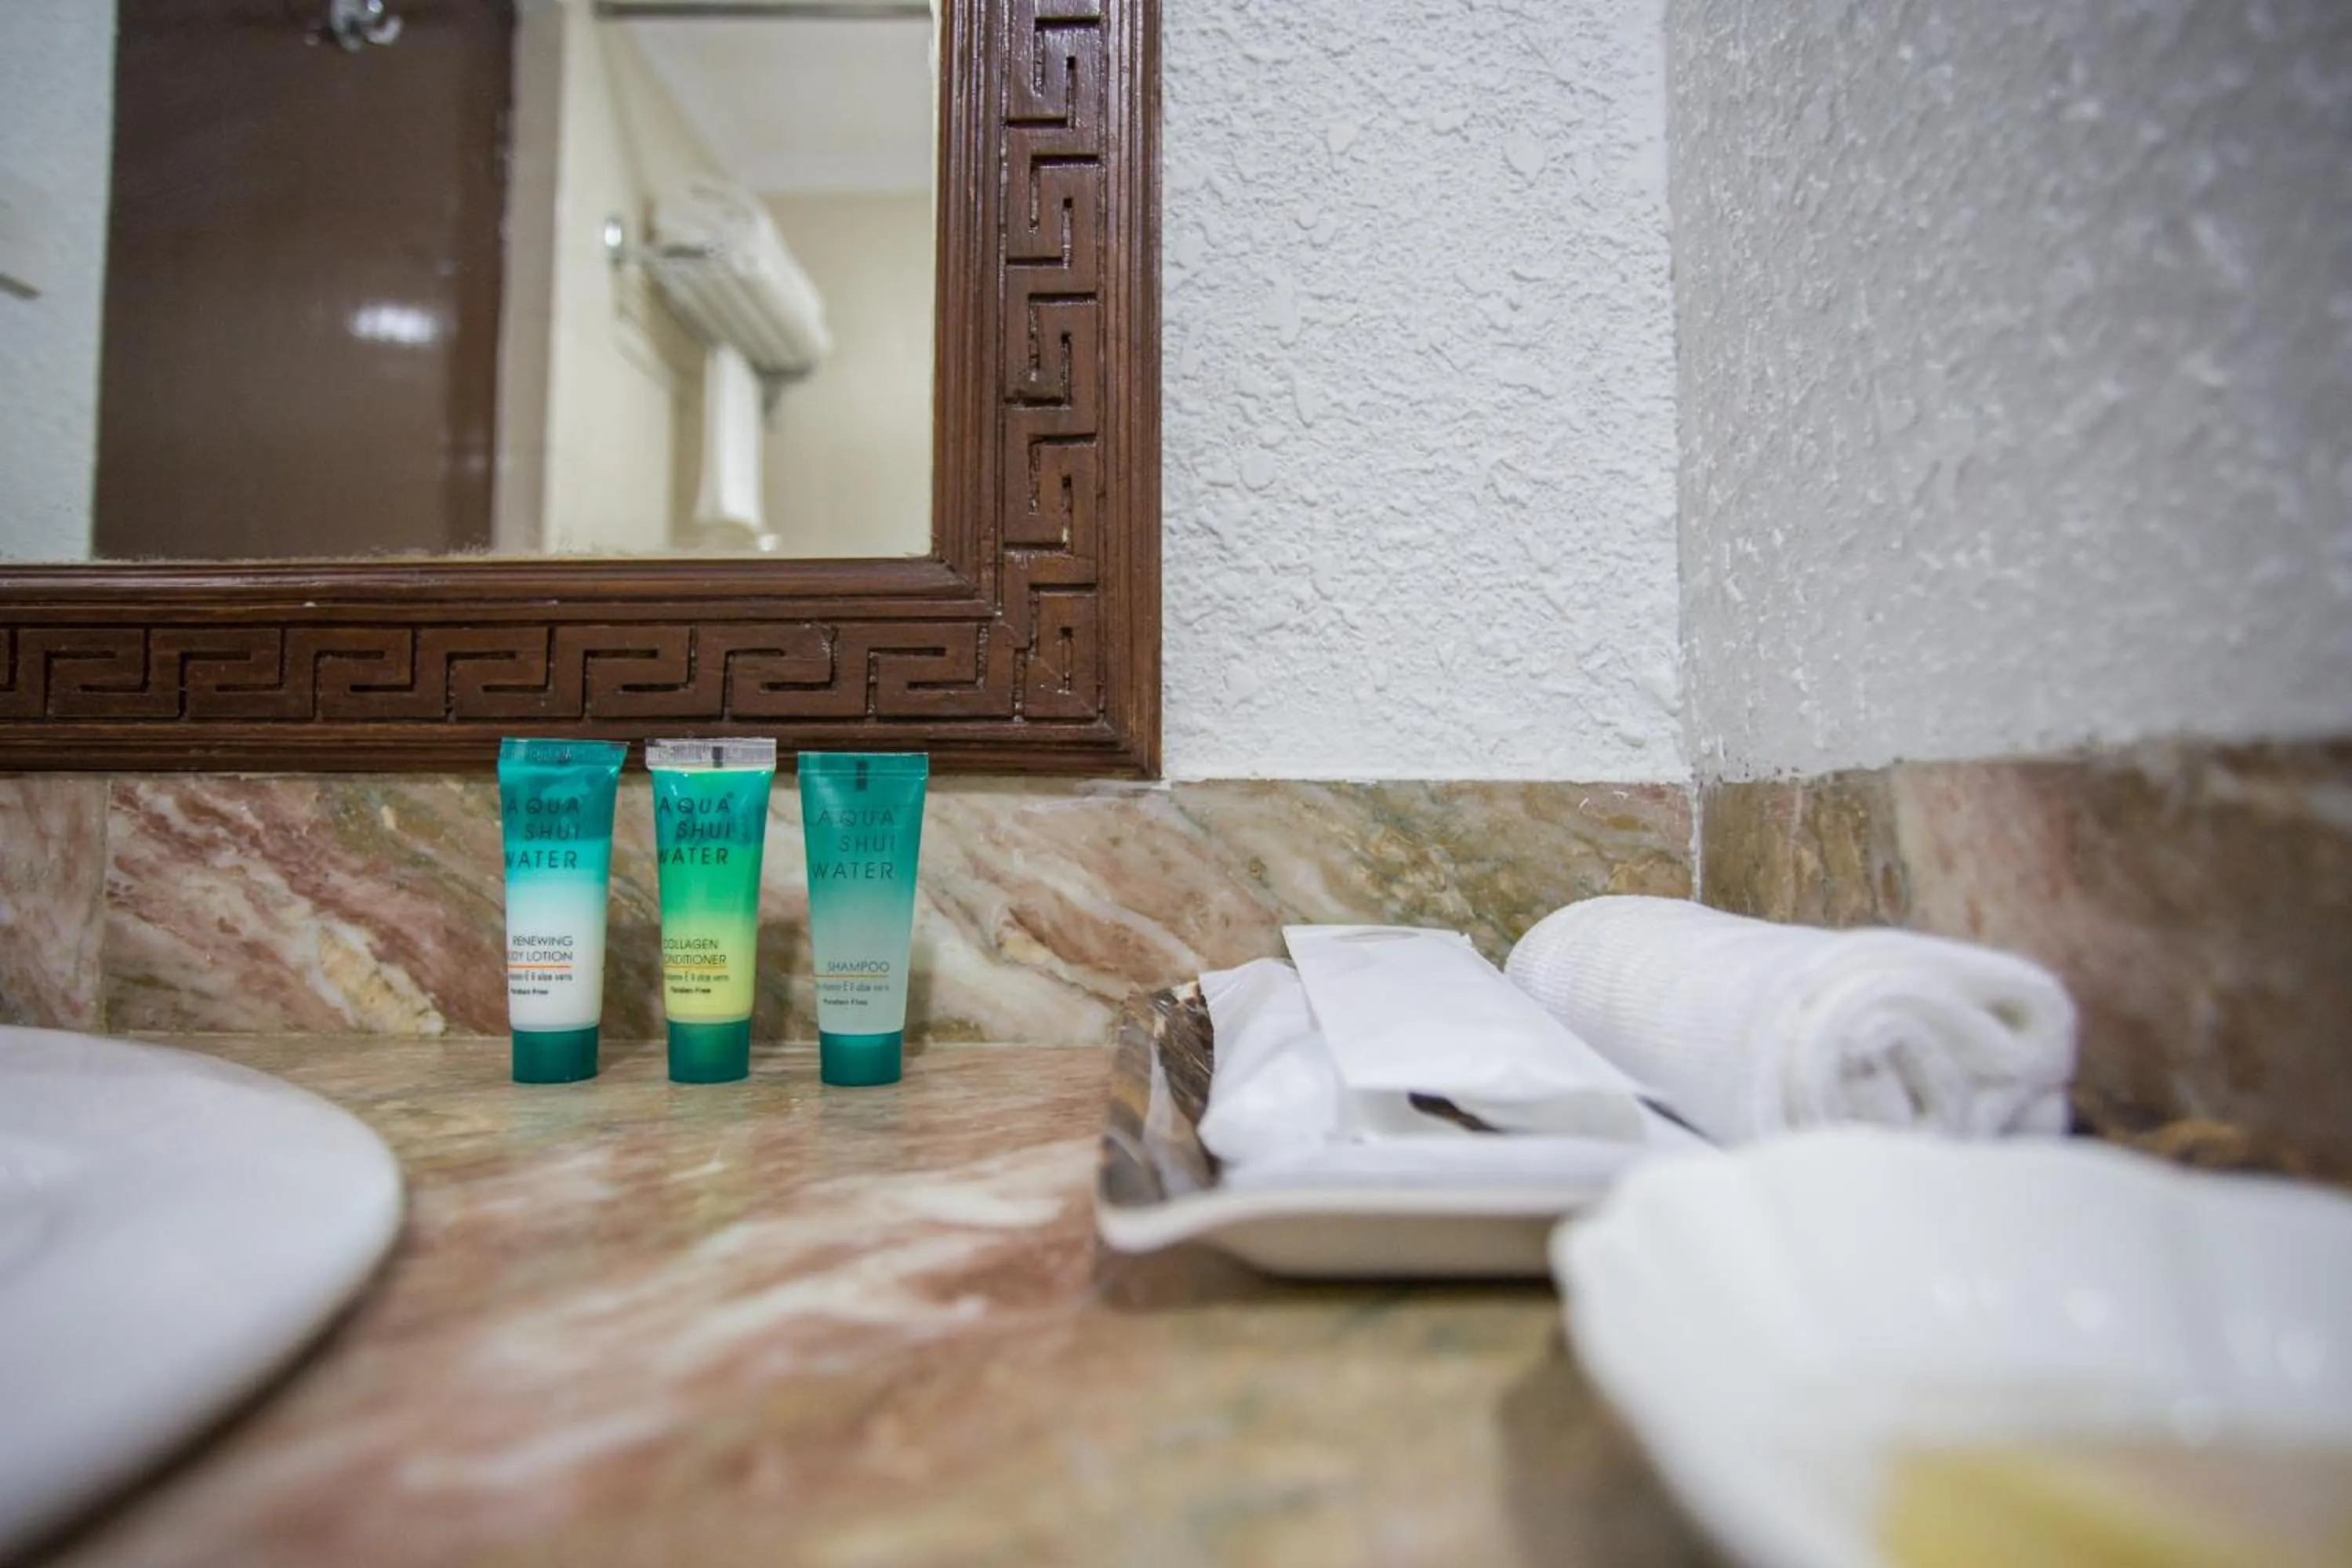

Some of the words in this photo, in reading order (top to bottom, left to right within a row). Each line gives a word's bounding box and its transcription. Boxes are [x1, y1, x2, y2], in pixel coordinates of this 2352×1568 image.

[506, 797, 580, 815] AQUA
[659, 796, 730, 815] AQUA
[818, 808, 895, 826] AQUA
[524, 822, 580, 841] SHUI
[677, 820, 731, 840] SHUI
[838, 834, 895, 853] SHUI
[812, 861, 893, 879] WATER
[512, 935, 573, 946] RENEWING
[663, 938, 719, 950] COLLAGEN
[526, 950, 573, 962] LOTION
[662, 953, 727, 965] ONDITIONER
[827, 960, 890, 972] SHAMPOO
